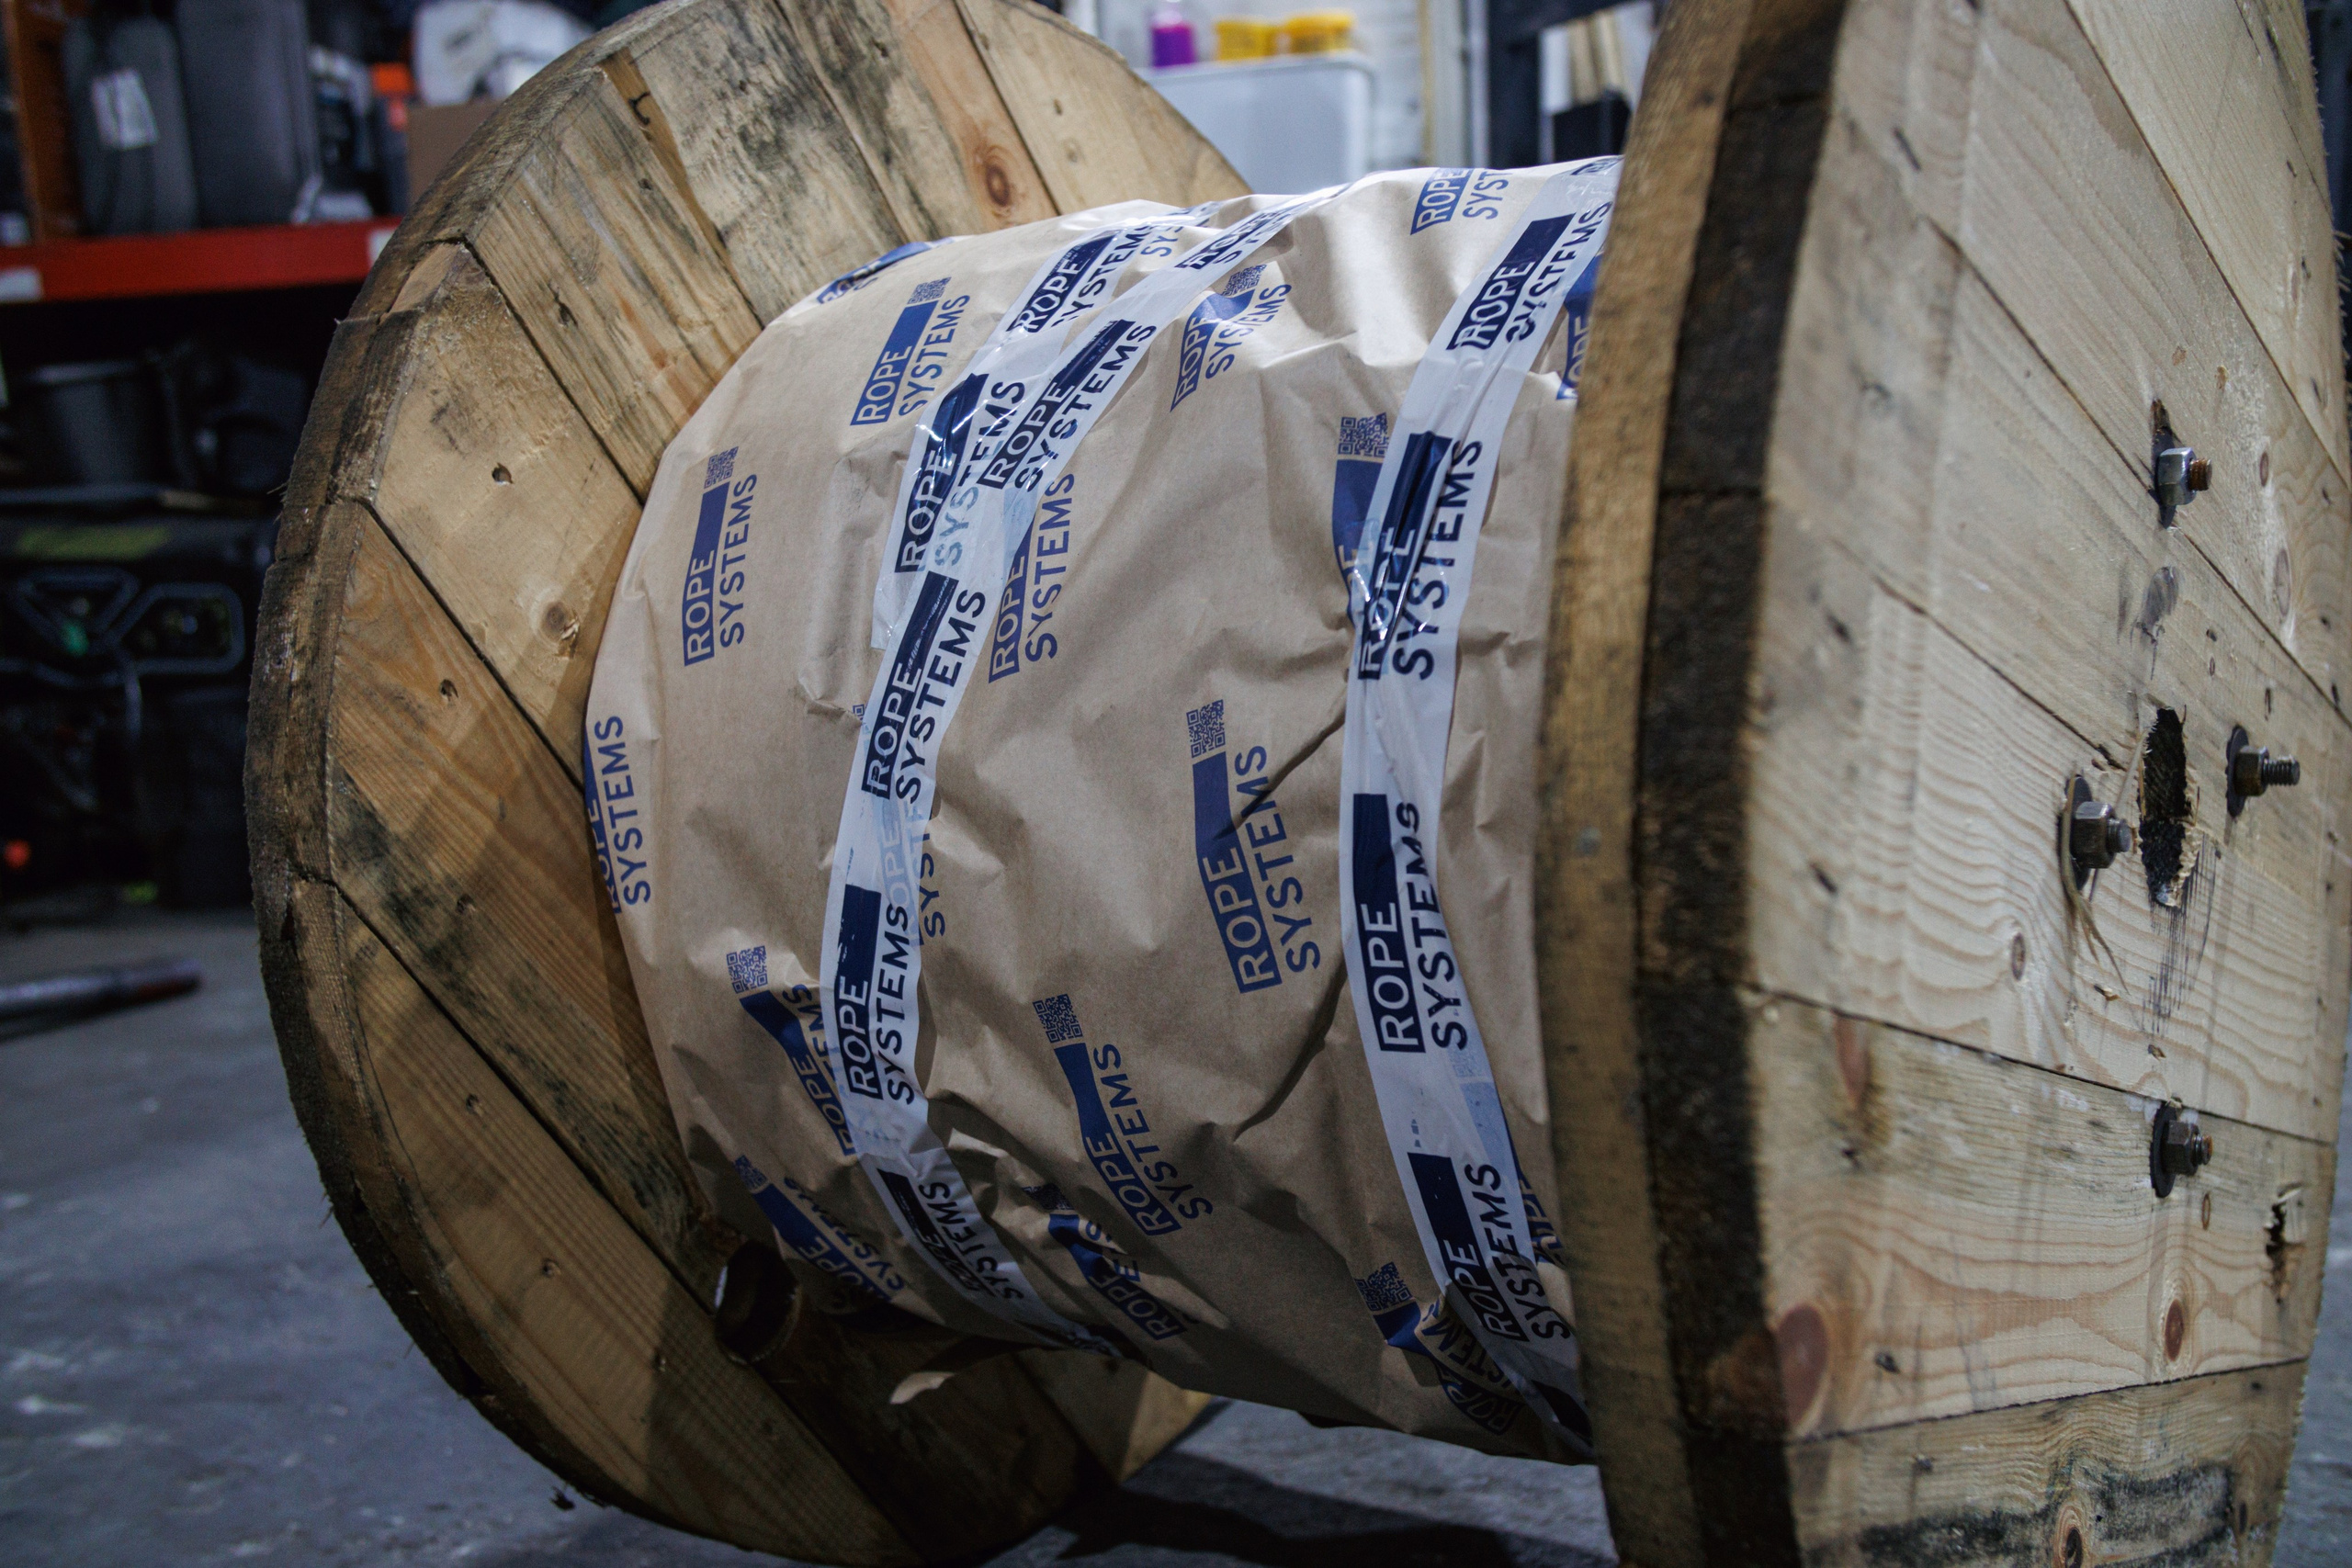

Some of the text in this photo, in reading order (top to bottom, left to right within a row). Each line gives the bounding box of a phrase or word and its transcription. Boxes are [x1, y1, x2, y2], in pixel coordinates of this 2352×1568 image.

[1416, 169, 1468, 230] ROPE
[899, 295, 970, 416] SYSTEMS
[1014, 258, 1091, 333] ROPE
[1455, 261, 1536, 347] ROPE
[856, 345, 913, 422] ROPE
[985, 382, 1074, 483] ROPE
[1014, 324, 1157, 492] SYSTEMS
[900, 449, 956, 567] ROPE
[934, 381, 1025, 567] SYSTEMS
[686, 550, 716, 660] ROPE
[719, 474, 757, 649] SYSTEMS
[991, 552, 1026, 678] ROPE
[1025, 472, 1074, 661] SYSTEMS
[1361, 527, 1415, 672] ROPE
[1392, 440, 1482, 681] SYSTEMS
[866, 662, 922, 792] ROPE
[896, 589, 986, 804] SYSTEMS
[594, 716, 650, 906] SYSTEMS
[1234, 746, 1320, 974] SYSTEMS
[1203, 847, 1273, 985] ROPE
[1361, 903, 1419, 1045] ROPE
[1396, 801, 1467, 1051] SYSTEMS
[839, 976, 879, 1094] ROPE
[875, 904, 916, 1104] SYSTEMS
[1086, 1133, 1173, 1232] ROPE
[1093, 1043, 1213, 1220] SYSTEMS
[1443, 1238, 1523, 1337] ROPE
[1464, 1164, 1571, 1339] SYSTEMS
